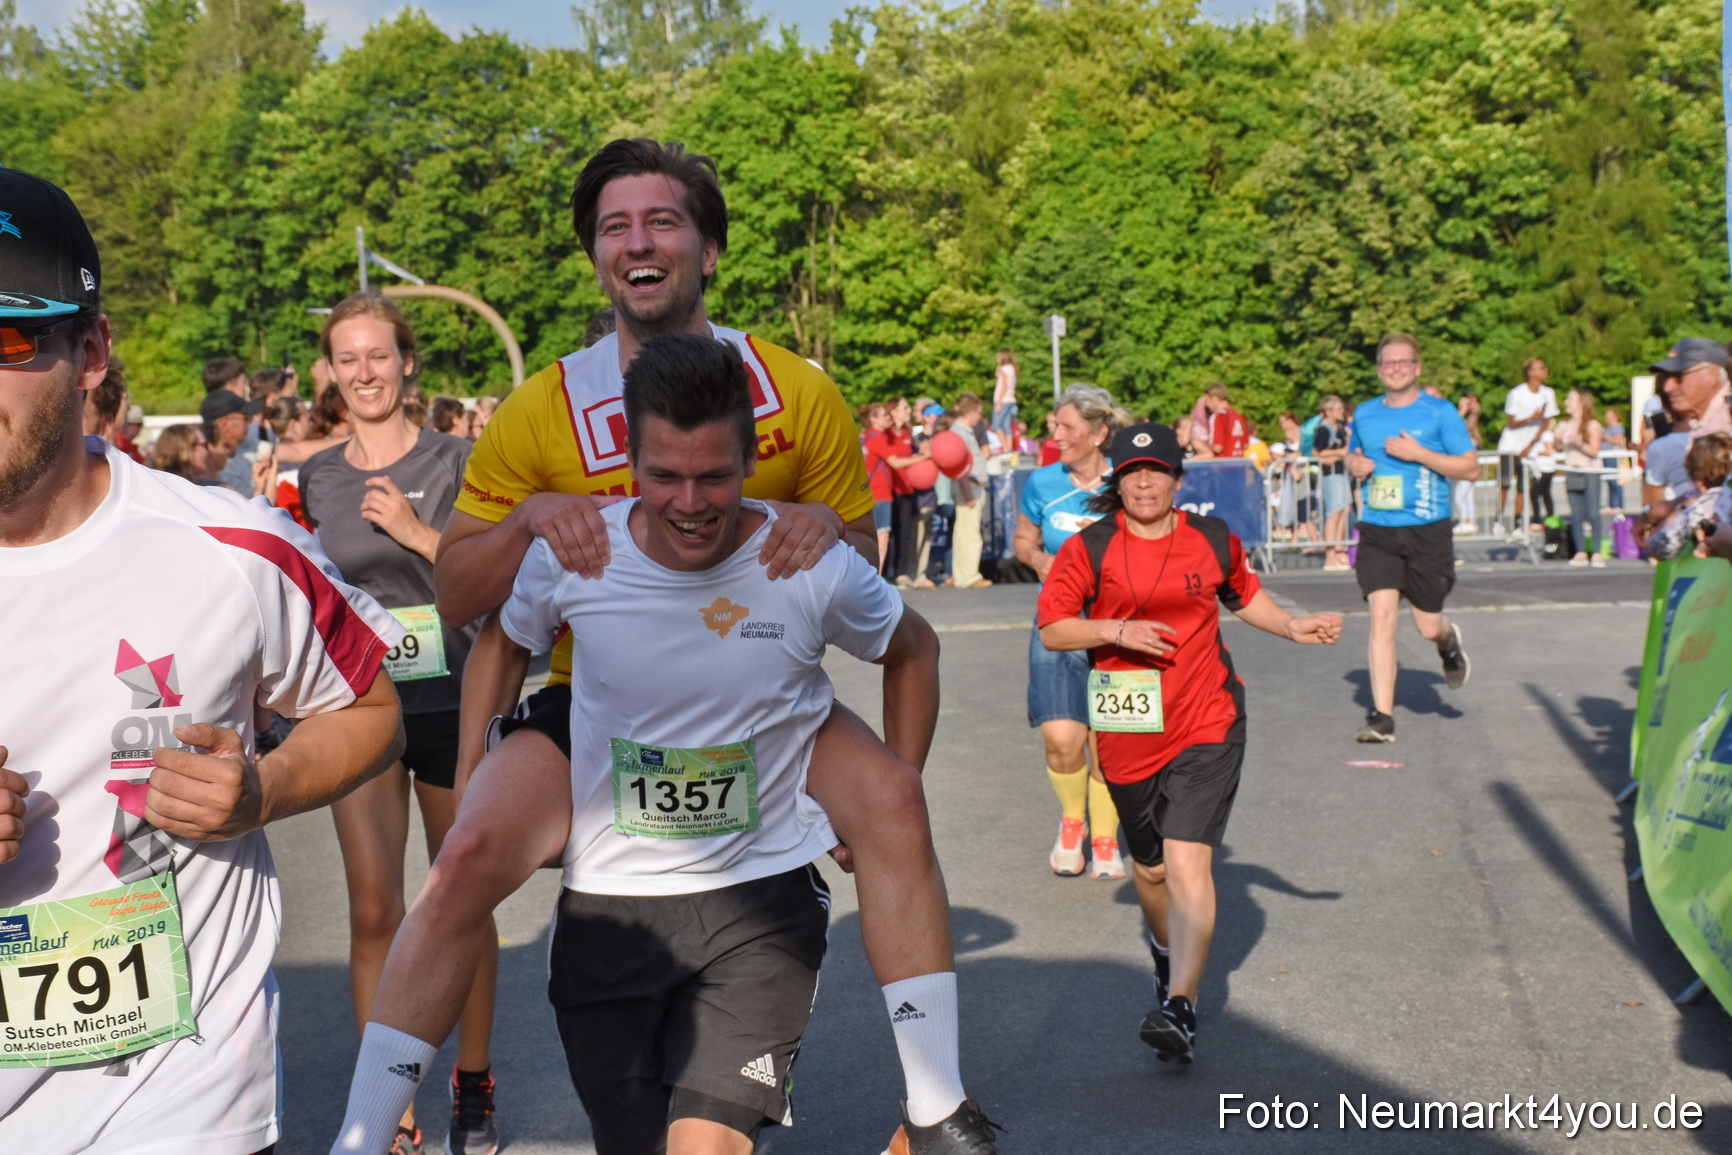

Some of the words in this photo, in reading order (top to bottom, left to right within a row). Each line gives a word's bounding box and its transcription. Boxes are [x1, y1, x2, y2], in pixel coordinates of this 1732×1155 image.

[1184, 573, 1202, 590] 13
[714, 611, 732, 622] NM
[741, 621, 785, 633] LANDKREIS
[740, 630, 785, 640] NEUMARKT
[1096, 692, 1150, 714] 2343
[111, 713, 192, 751] OM
[112, 750, 146, 759] KLEBE
[721, 765, 745, 776] 2019
[630, 776, 736, 813] 1357
[630, 819, 674, 830] Landratsamt
[676, 821, 712, 830] Neumarkt
[642, 812, 690, 823] Queitsch
[693, 812, 727, 822] Marco
[90, 893, 130, 908] Gesunde
[127, 920, 166, 943] 2019
[5, 1023, 68, 1040] Sutsch
[73, 1006, 142, 1034] Michael
[892, 1011, 926, 1024] adidas
[4, 1033, 107, 1053] OM-Klebetechnik
[110, 1022, 147, 1040] GmbH
[741, 1065, 777, 1088] adidas
